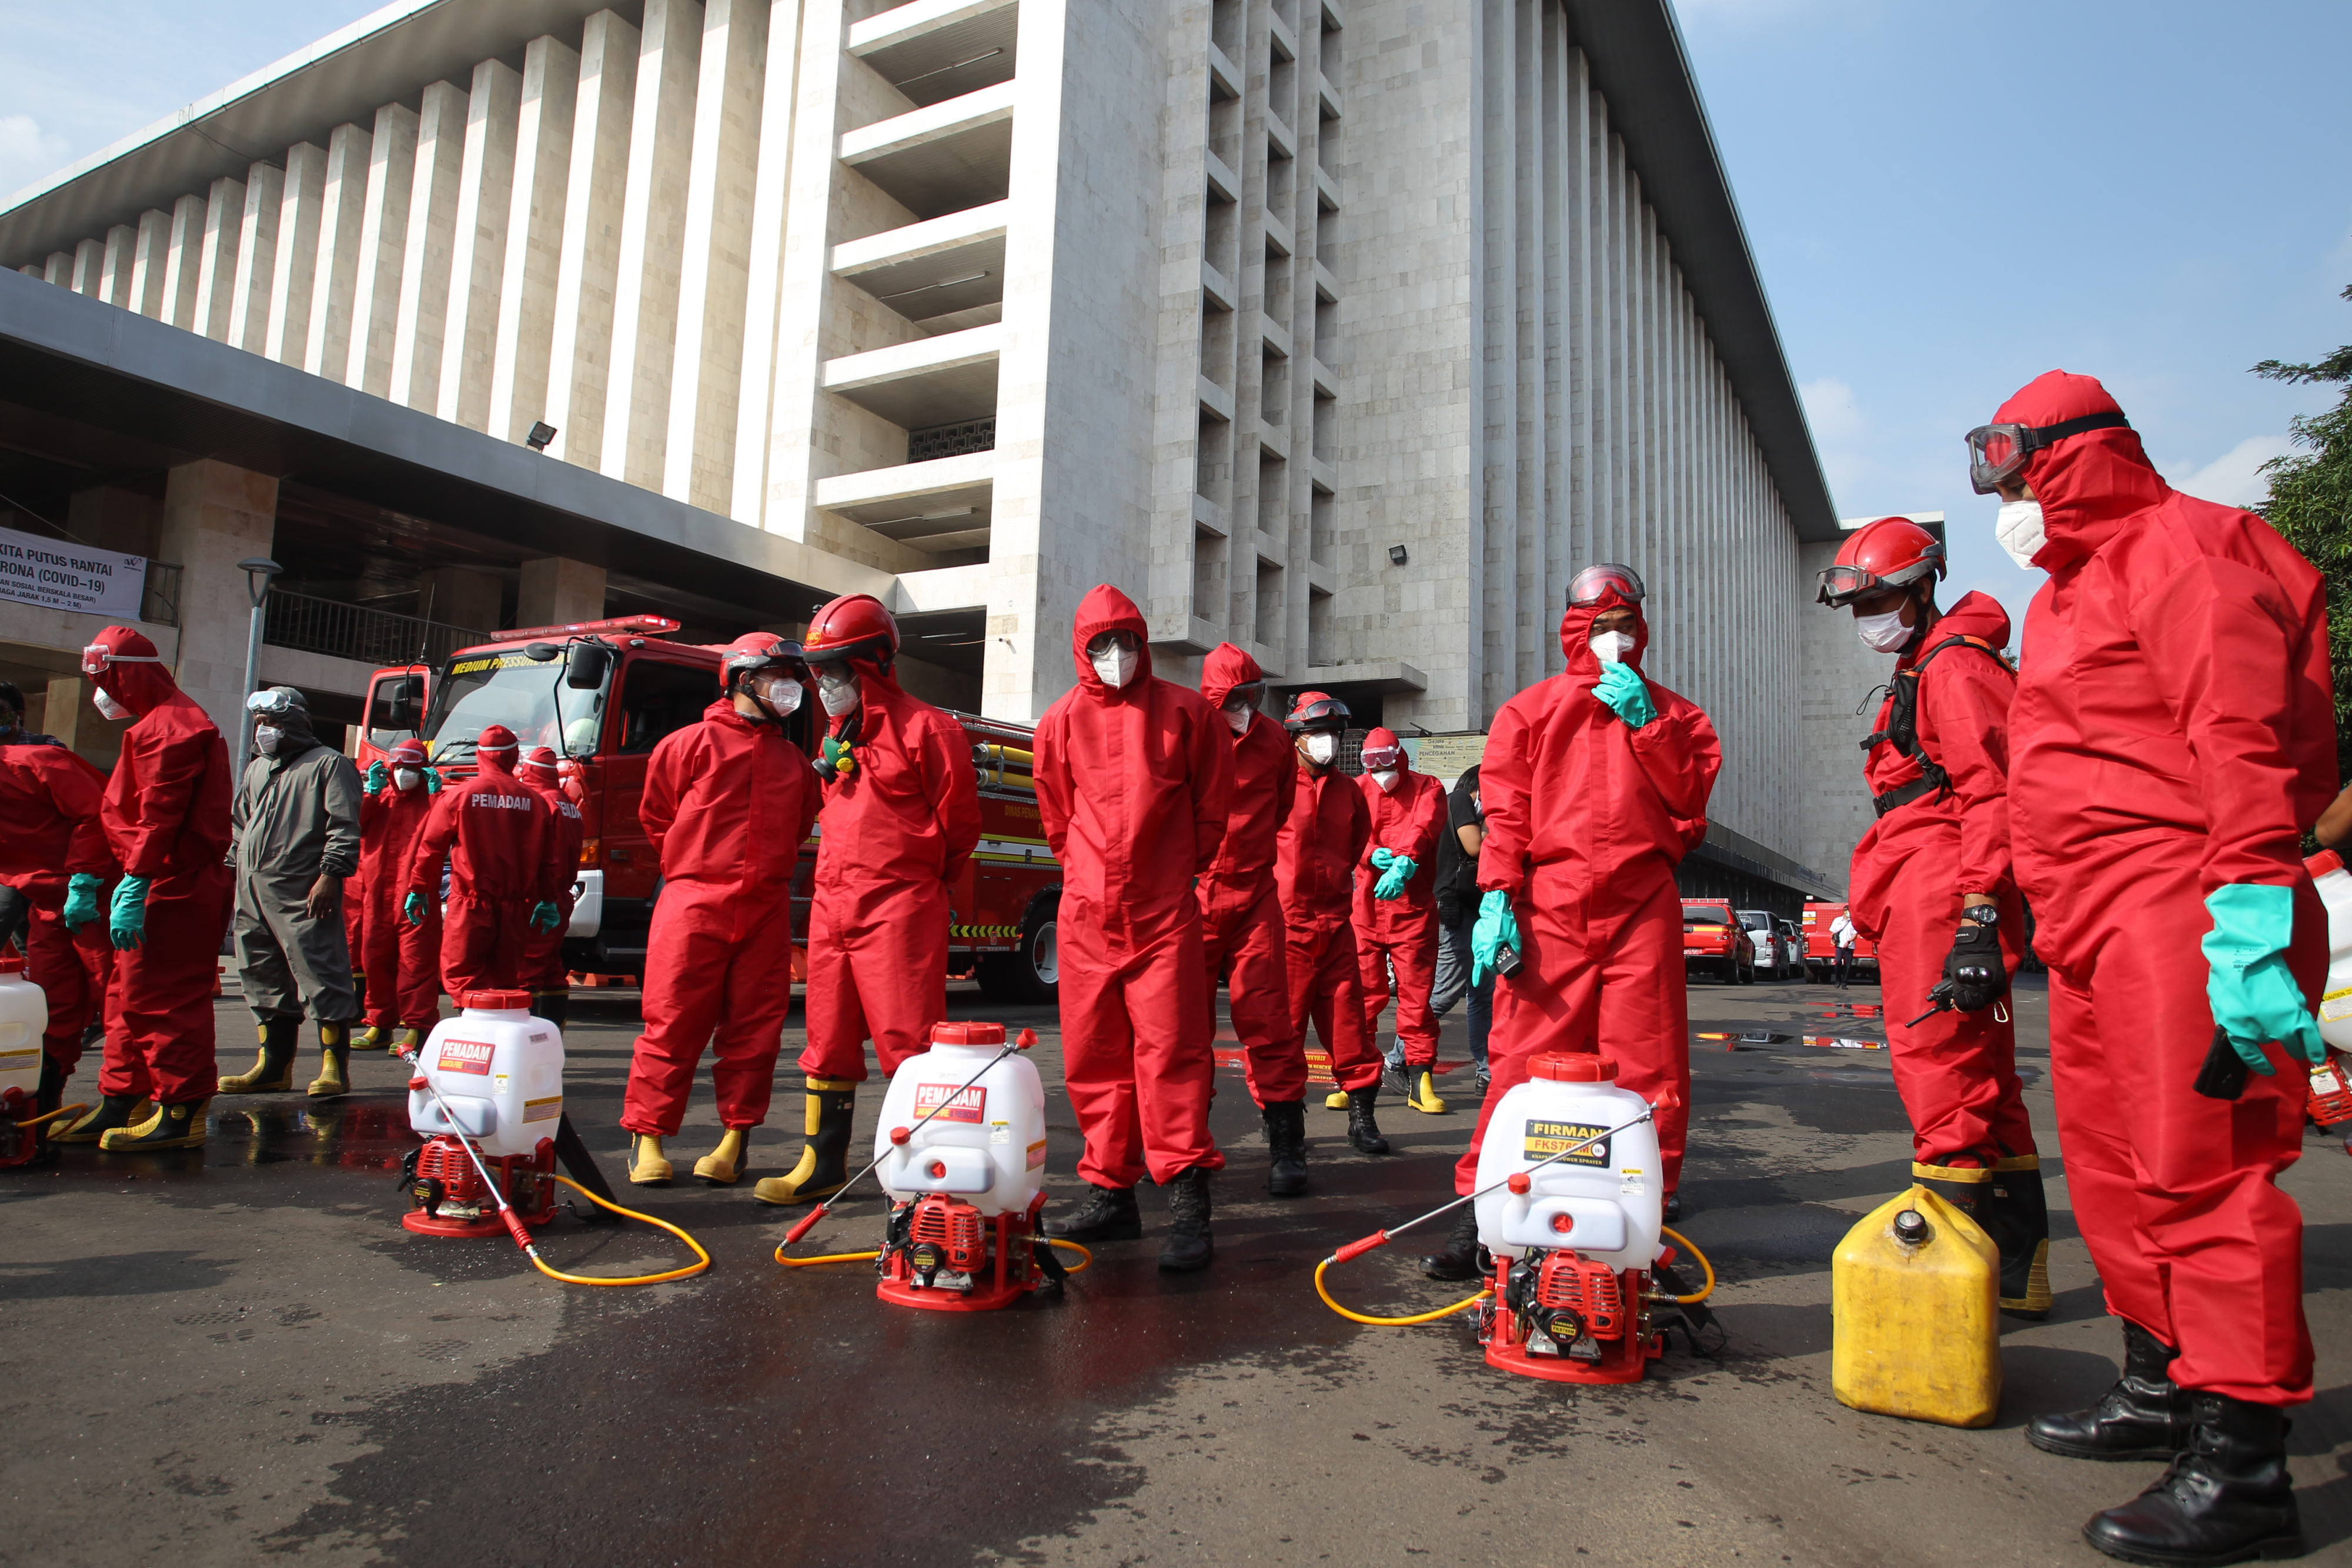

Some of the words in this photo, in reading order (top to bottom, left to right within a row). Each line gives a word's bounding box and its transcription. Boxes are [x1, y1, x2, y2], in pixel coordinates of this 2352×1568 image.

[28, 549, 67, 566] PUTUS
[71, 558, 112, 576] RANTAI
[39, 569, 105, 595] (COVID-19)
[11, 581, 35, 591] SOSIAL
[38, 586, 71, 598] BERSKALA
[73, 593, 96, 603] BESAR)
[17, 591, 39, 600] JARAK
[452, 659, 491, 675] MEDIUM
[472, 794, 530, 811] PEMADAM
[2324, 992, 2346, 1001] CAUTION
[442, 1042, 491, 1061] PEMADAM
[918, 1086, 982, 1108] PEMADAM
[1534, 1124, 1602, 1139] FIRMAN
